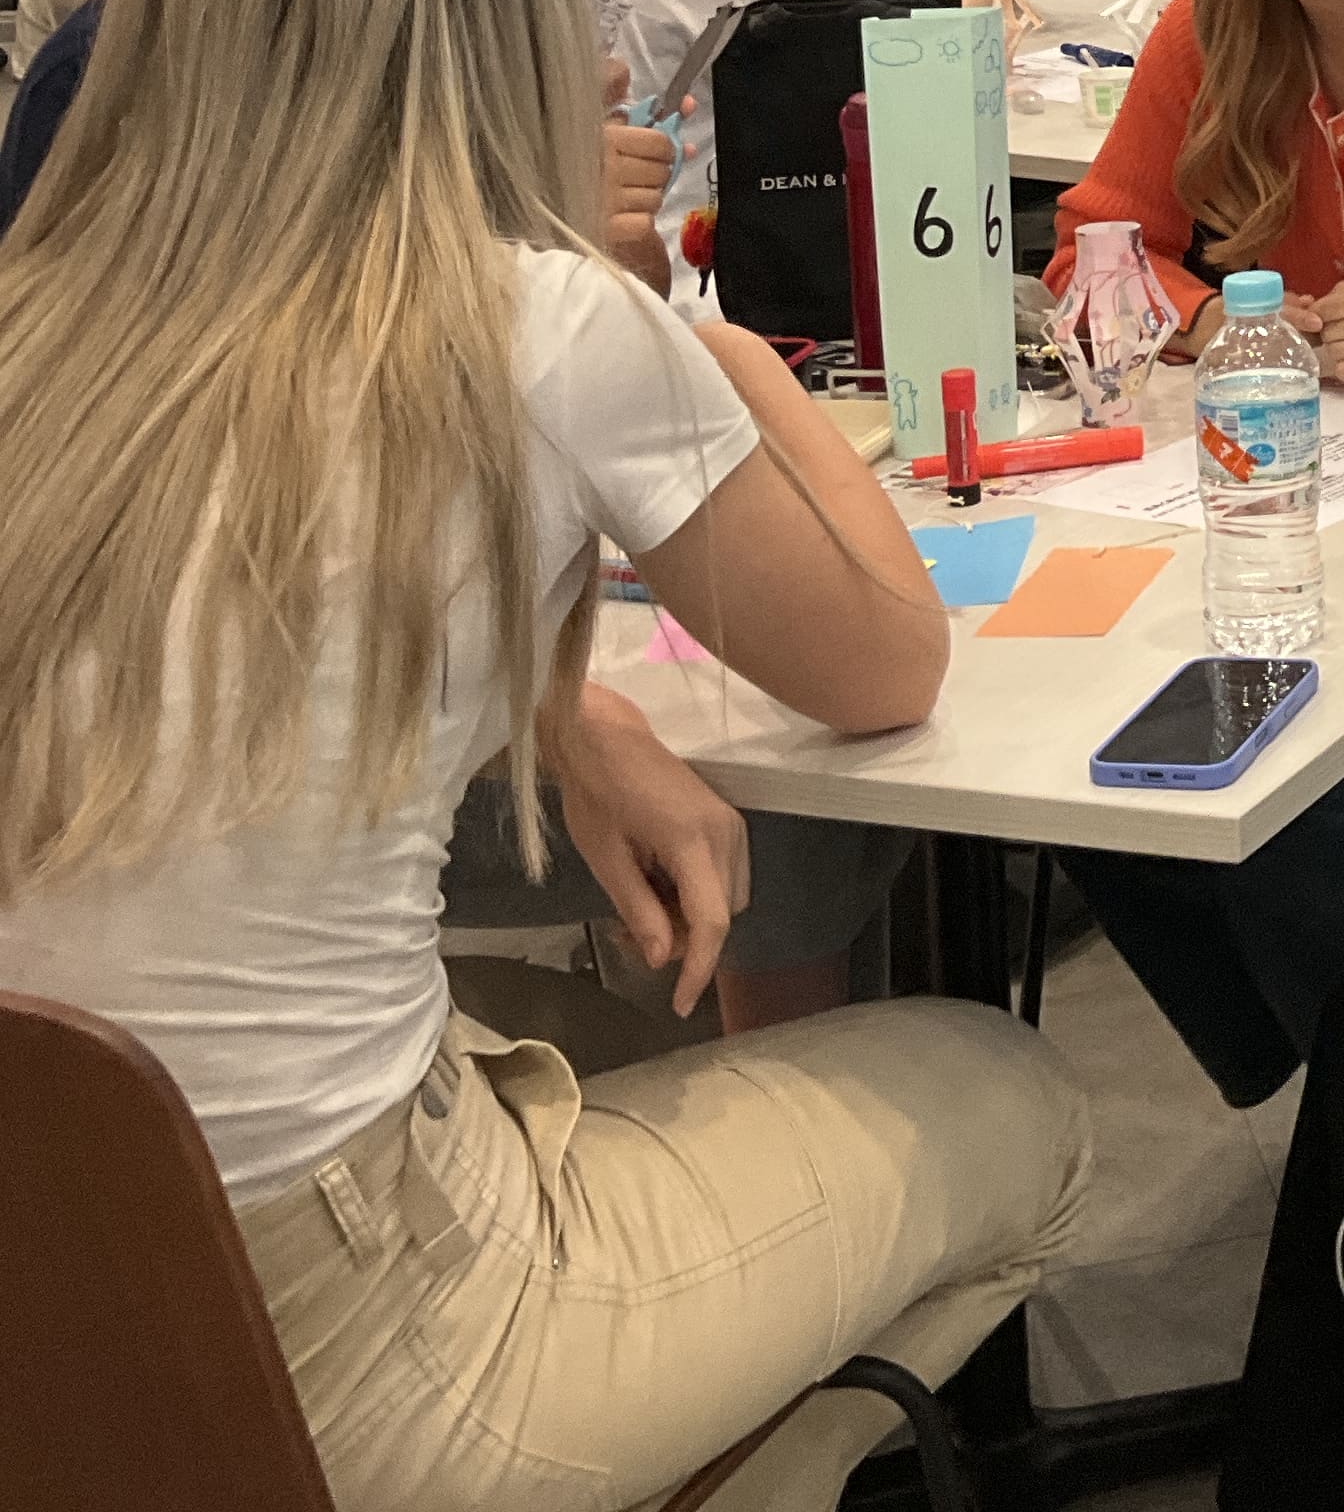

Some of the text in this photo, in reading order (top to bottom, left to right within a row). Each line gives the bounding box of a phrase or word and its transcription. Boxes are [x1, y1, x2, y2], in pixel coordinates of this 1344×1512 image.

[759, 174, 818, 191] DEAN
[823, 173, 837, 187] &
[913, 187, 954, 258] 6
[985, 183, 1003, 258] 6
